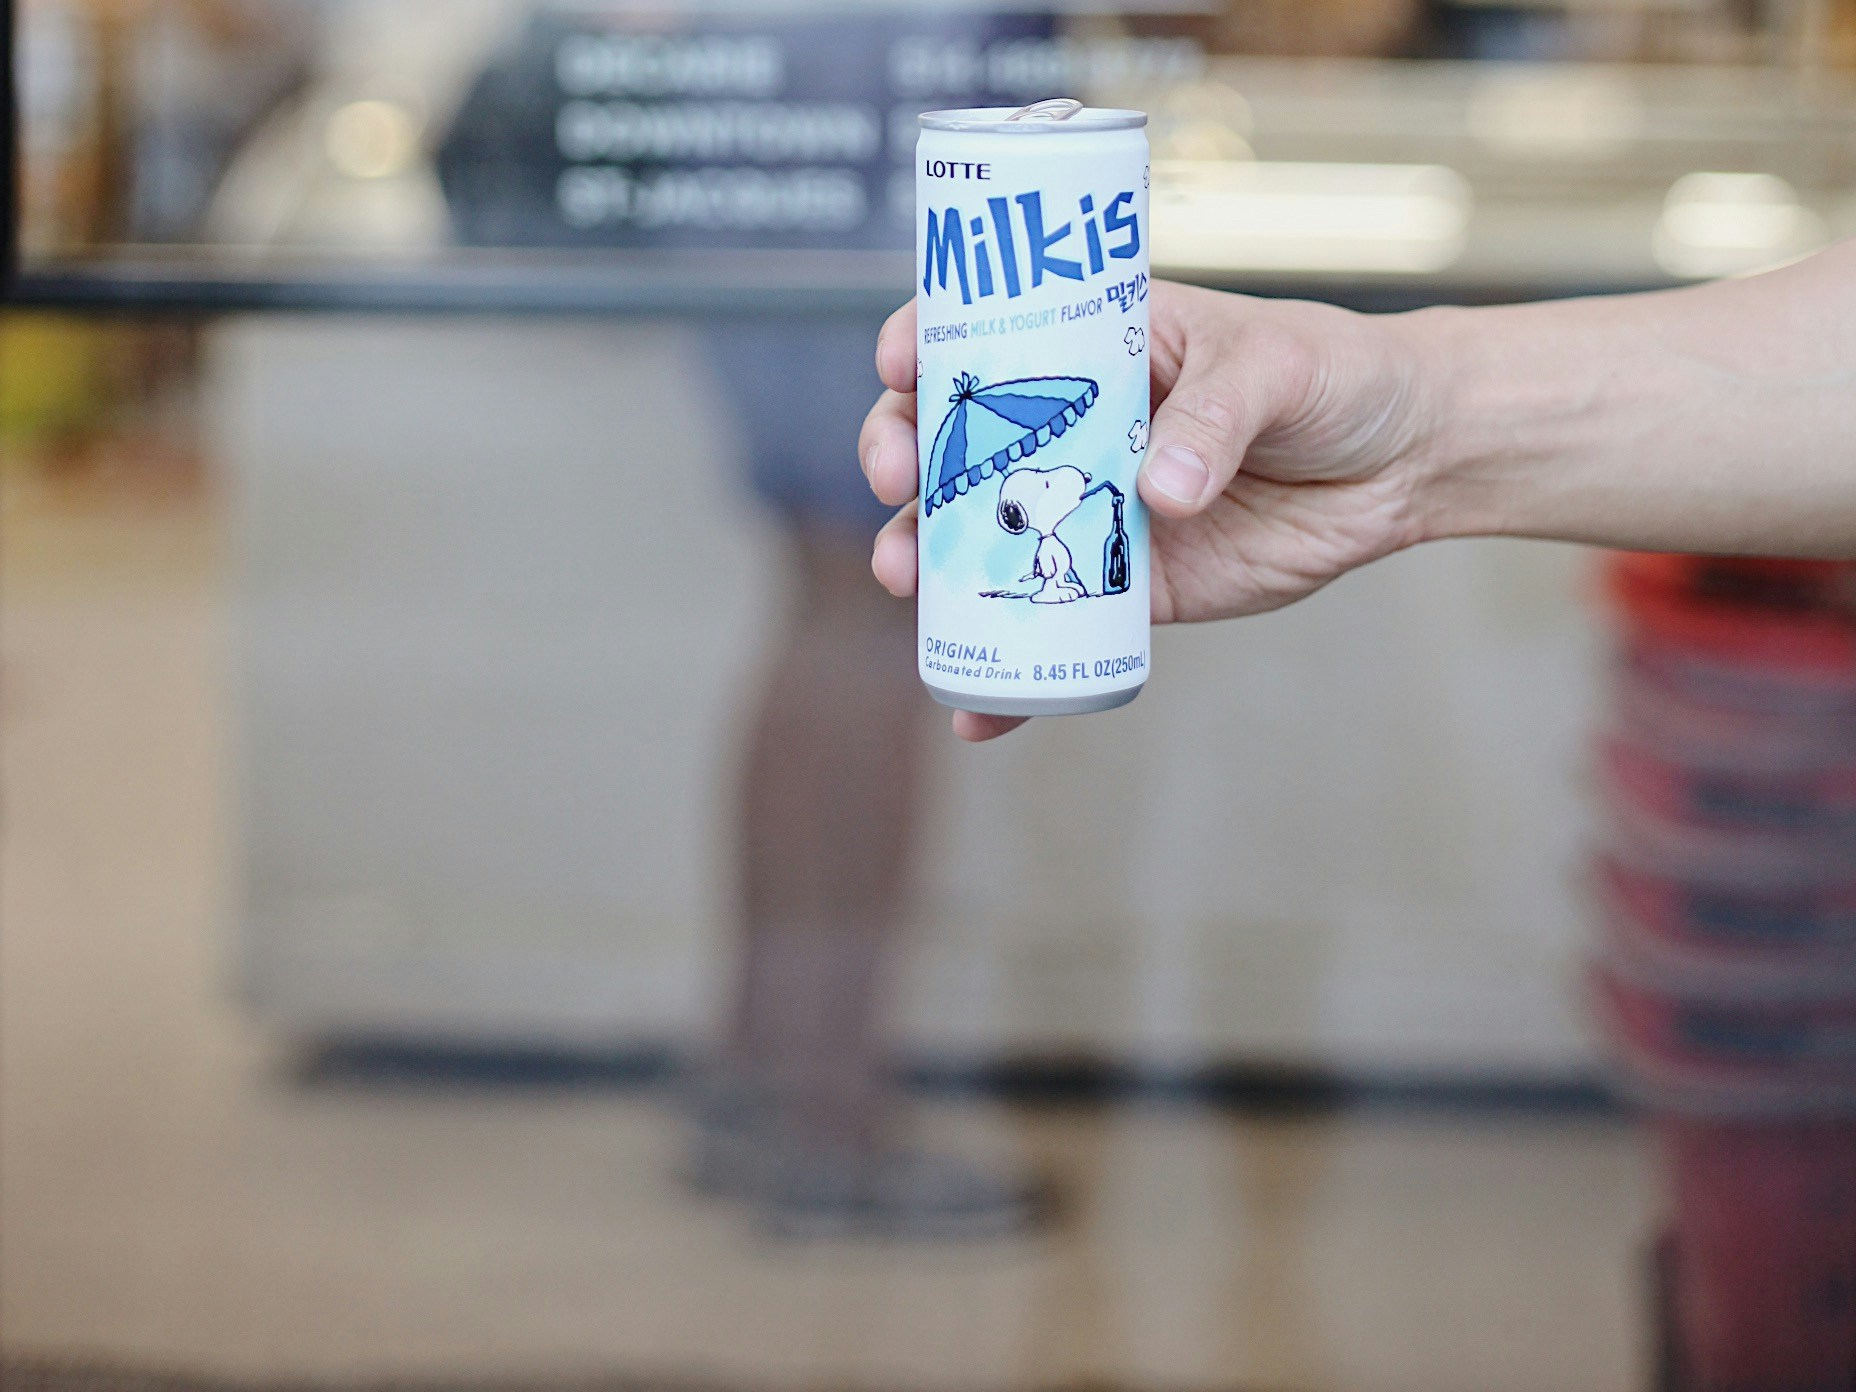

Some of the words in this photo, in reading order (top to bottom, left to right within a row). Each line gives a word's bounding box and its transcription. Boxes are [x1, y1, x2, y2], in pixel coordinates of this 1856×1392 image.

[926, 160, 991, 180] LOTTE
[923, 190, 1140, 305] Milkis
[1105, 272, 1148, 314] 밀키스
[924, 322, 968, 344] REFRESHING
[970, 319, 996, 338] MILK
[998, 317, 1007, 334] &
[1009, 308, 1057, 333] YOGURT
[1061, 298, 1102, 323] FLAVOR
[926, 637, 1001, 663] ORIGINAL
[925, 656, 981, 678] Carbonated
[985, 666, 1021, 680] Drink
[1033, 664, 1067, 681] 8.45
[1073, 663, 1089, 679] FL
